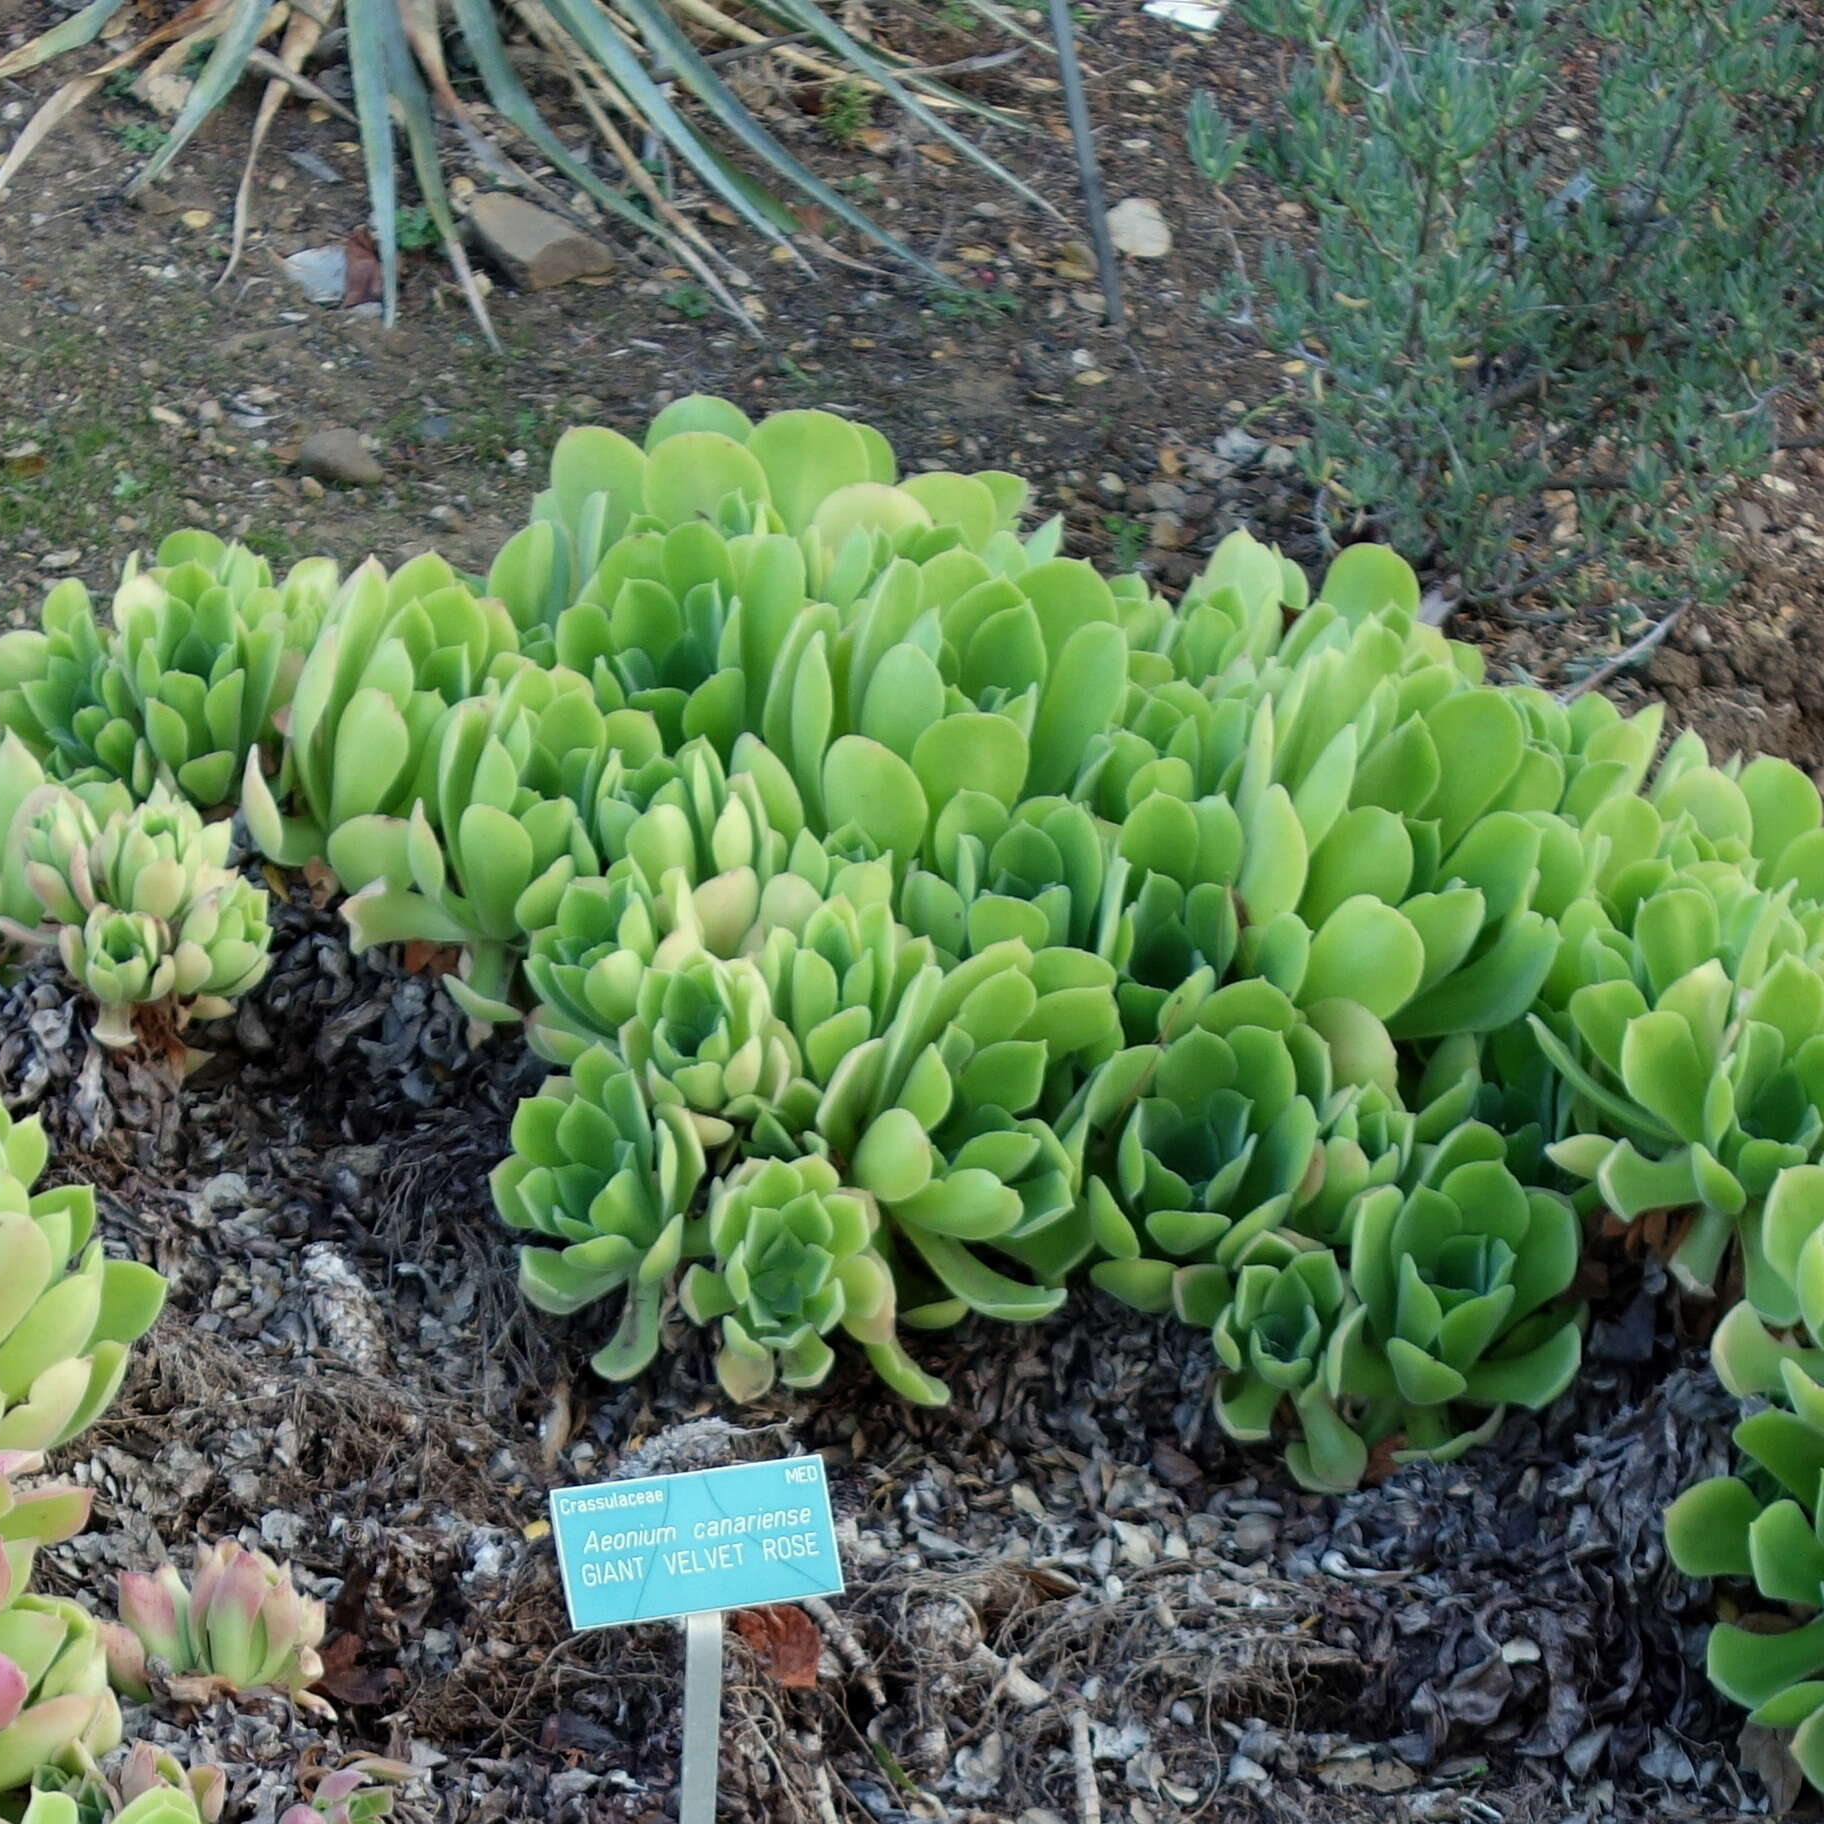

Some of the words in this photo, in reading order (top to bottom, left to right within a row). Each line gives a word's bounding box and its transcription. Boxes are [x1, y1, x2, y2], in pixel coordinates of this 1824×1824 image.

[784, 1465, 819, 1485] MED
[560, 1489, 664, 1516] Crassulaceae
[583, 1523, 676, 1554] Aeonium
[693, 1506, 812, 1541] canariense
[580, 1556, 644, 1587] GIANT
[663, 1542, 744, 1576] VELVET
[761, 1532, 820, 1562] ROSE
